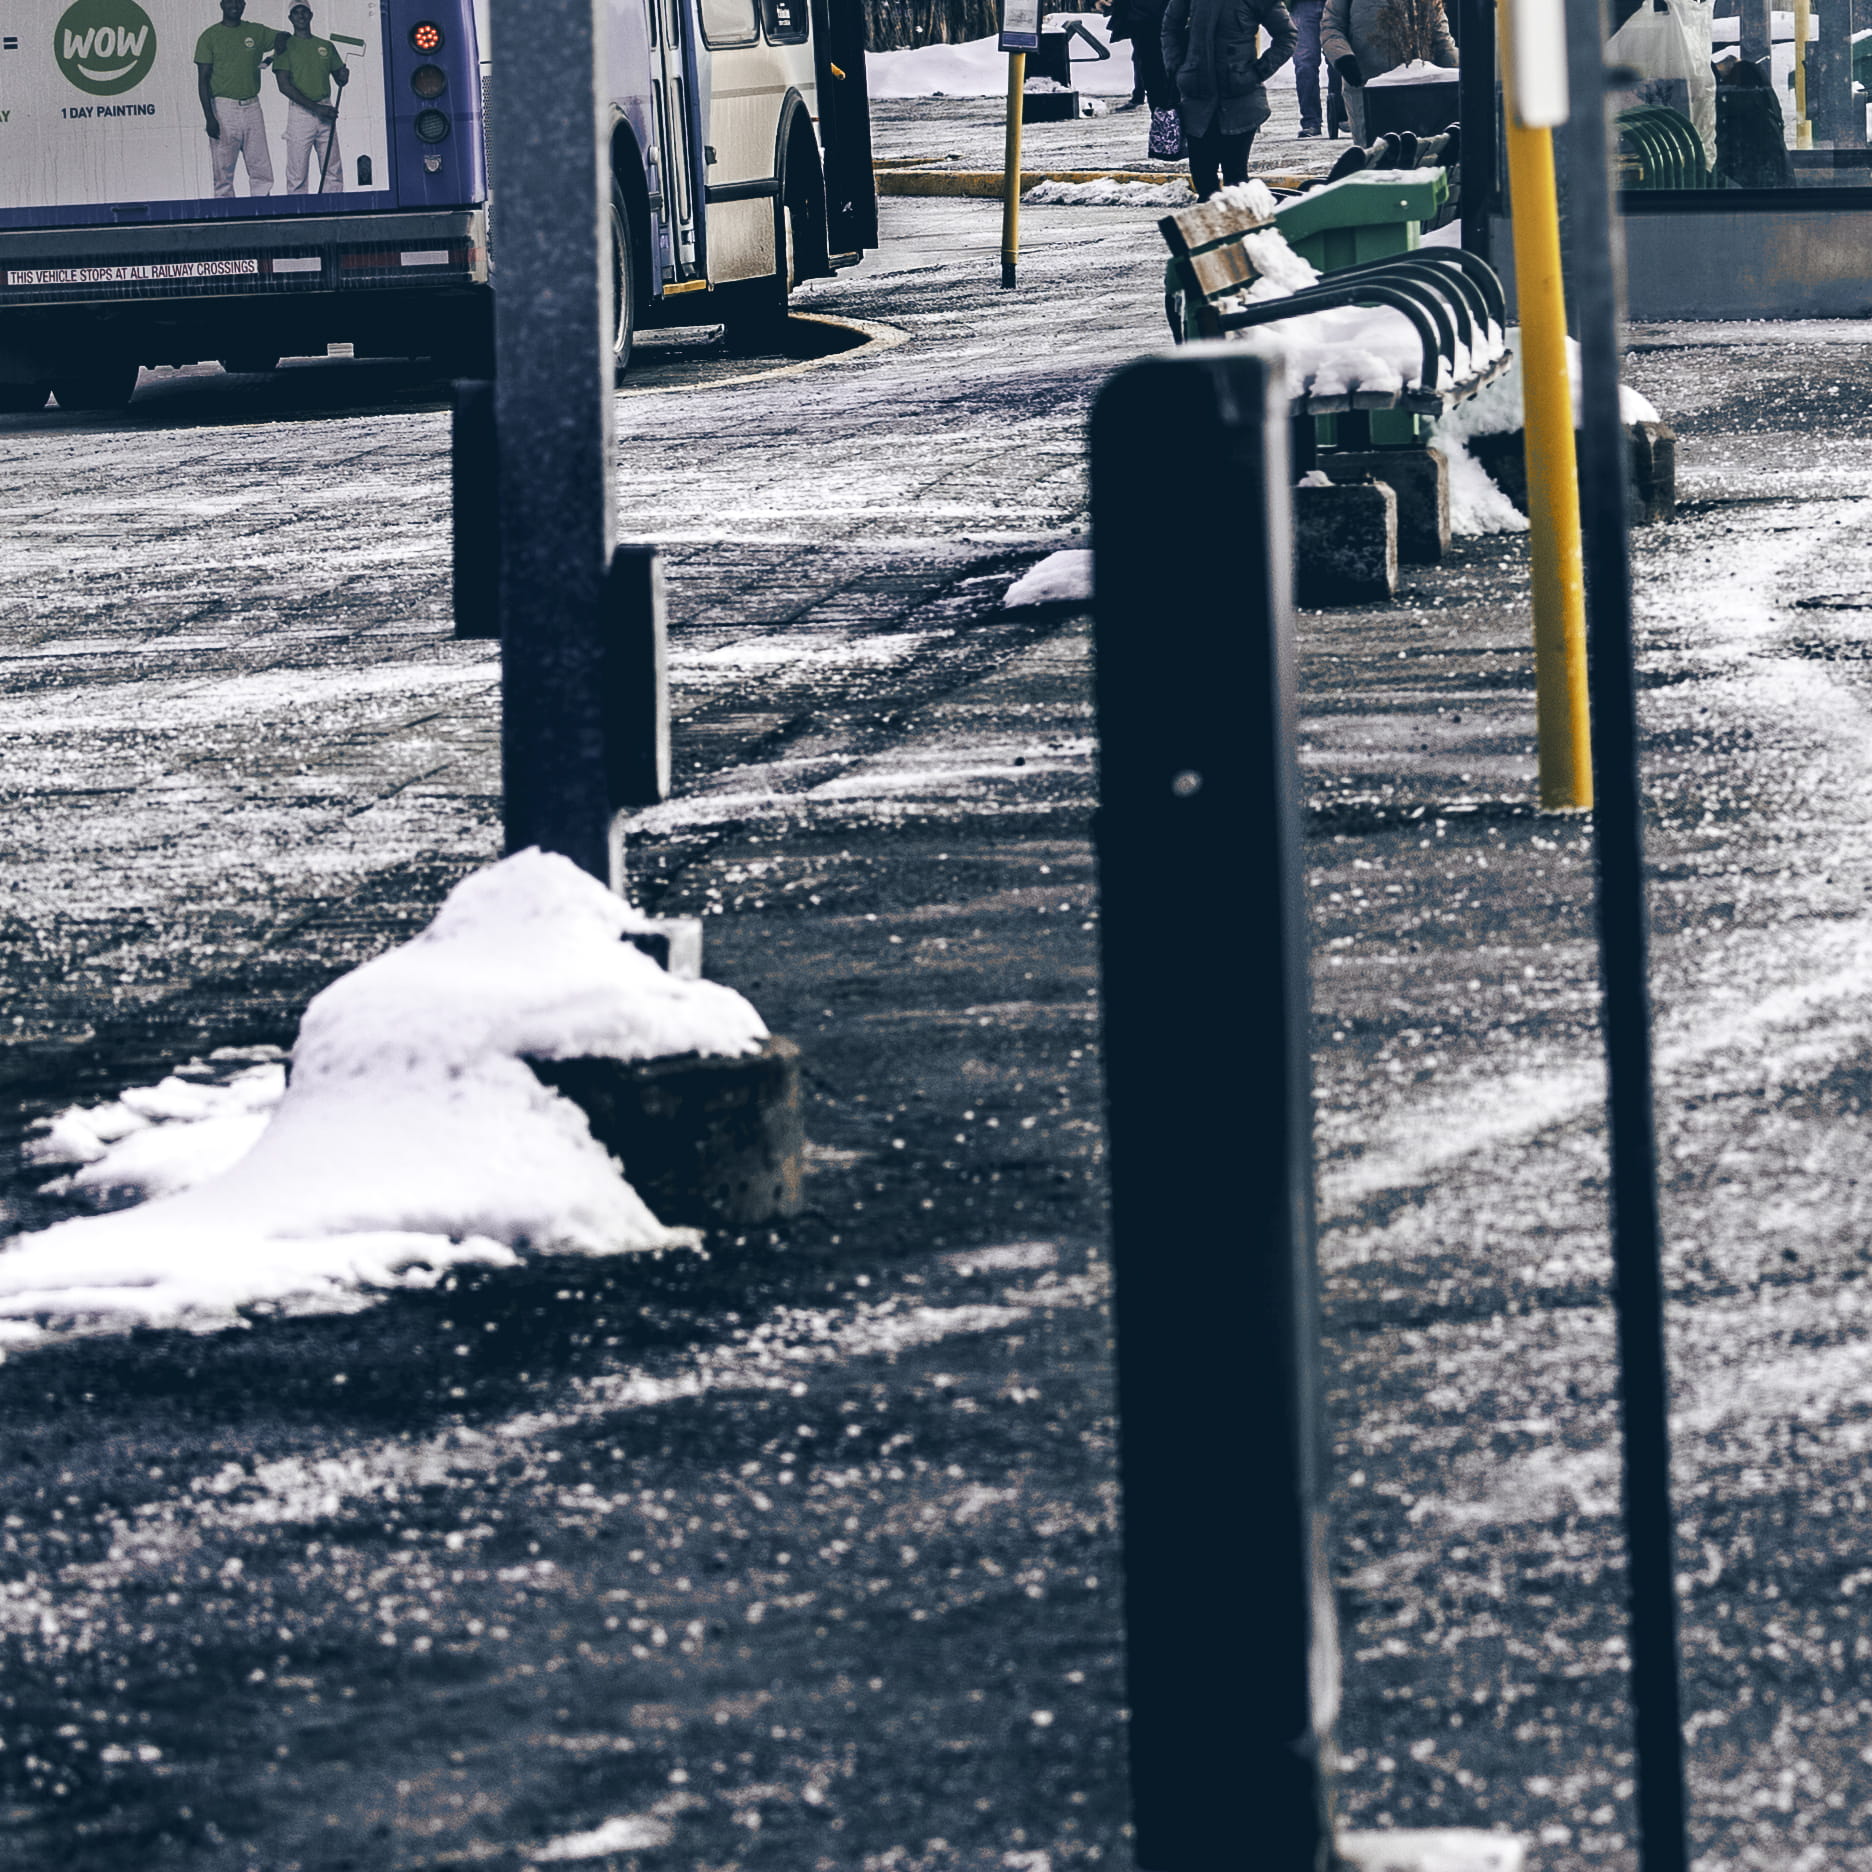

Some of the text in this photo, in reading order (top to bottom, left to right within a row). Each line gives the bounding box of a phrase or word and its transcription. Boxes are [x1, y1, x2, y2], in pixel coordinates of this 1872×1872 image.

[63, 24, 149, 60] WOW
[61, 103, 156, 120] 1 DAY PAINTING
[10, 259, 255, 285] THIS VEHICLE STOPS AT ALL RAILWAY CROSSINGS
